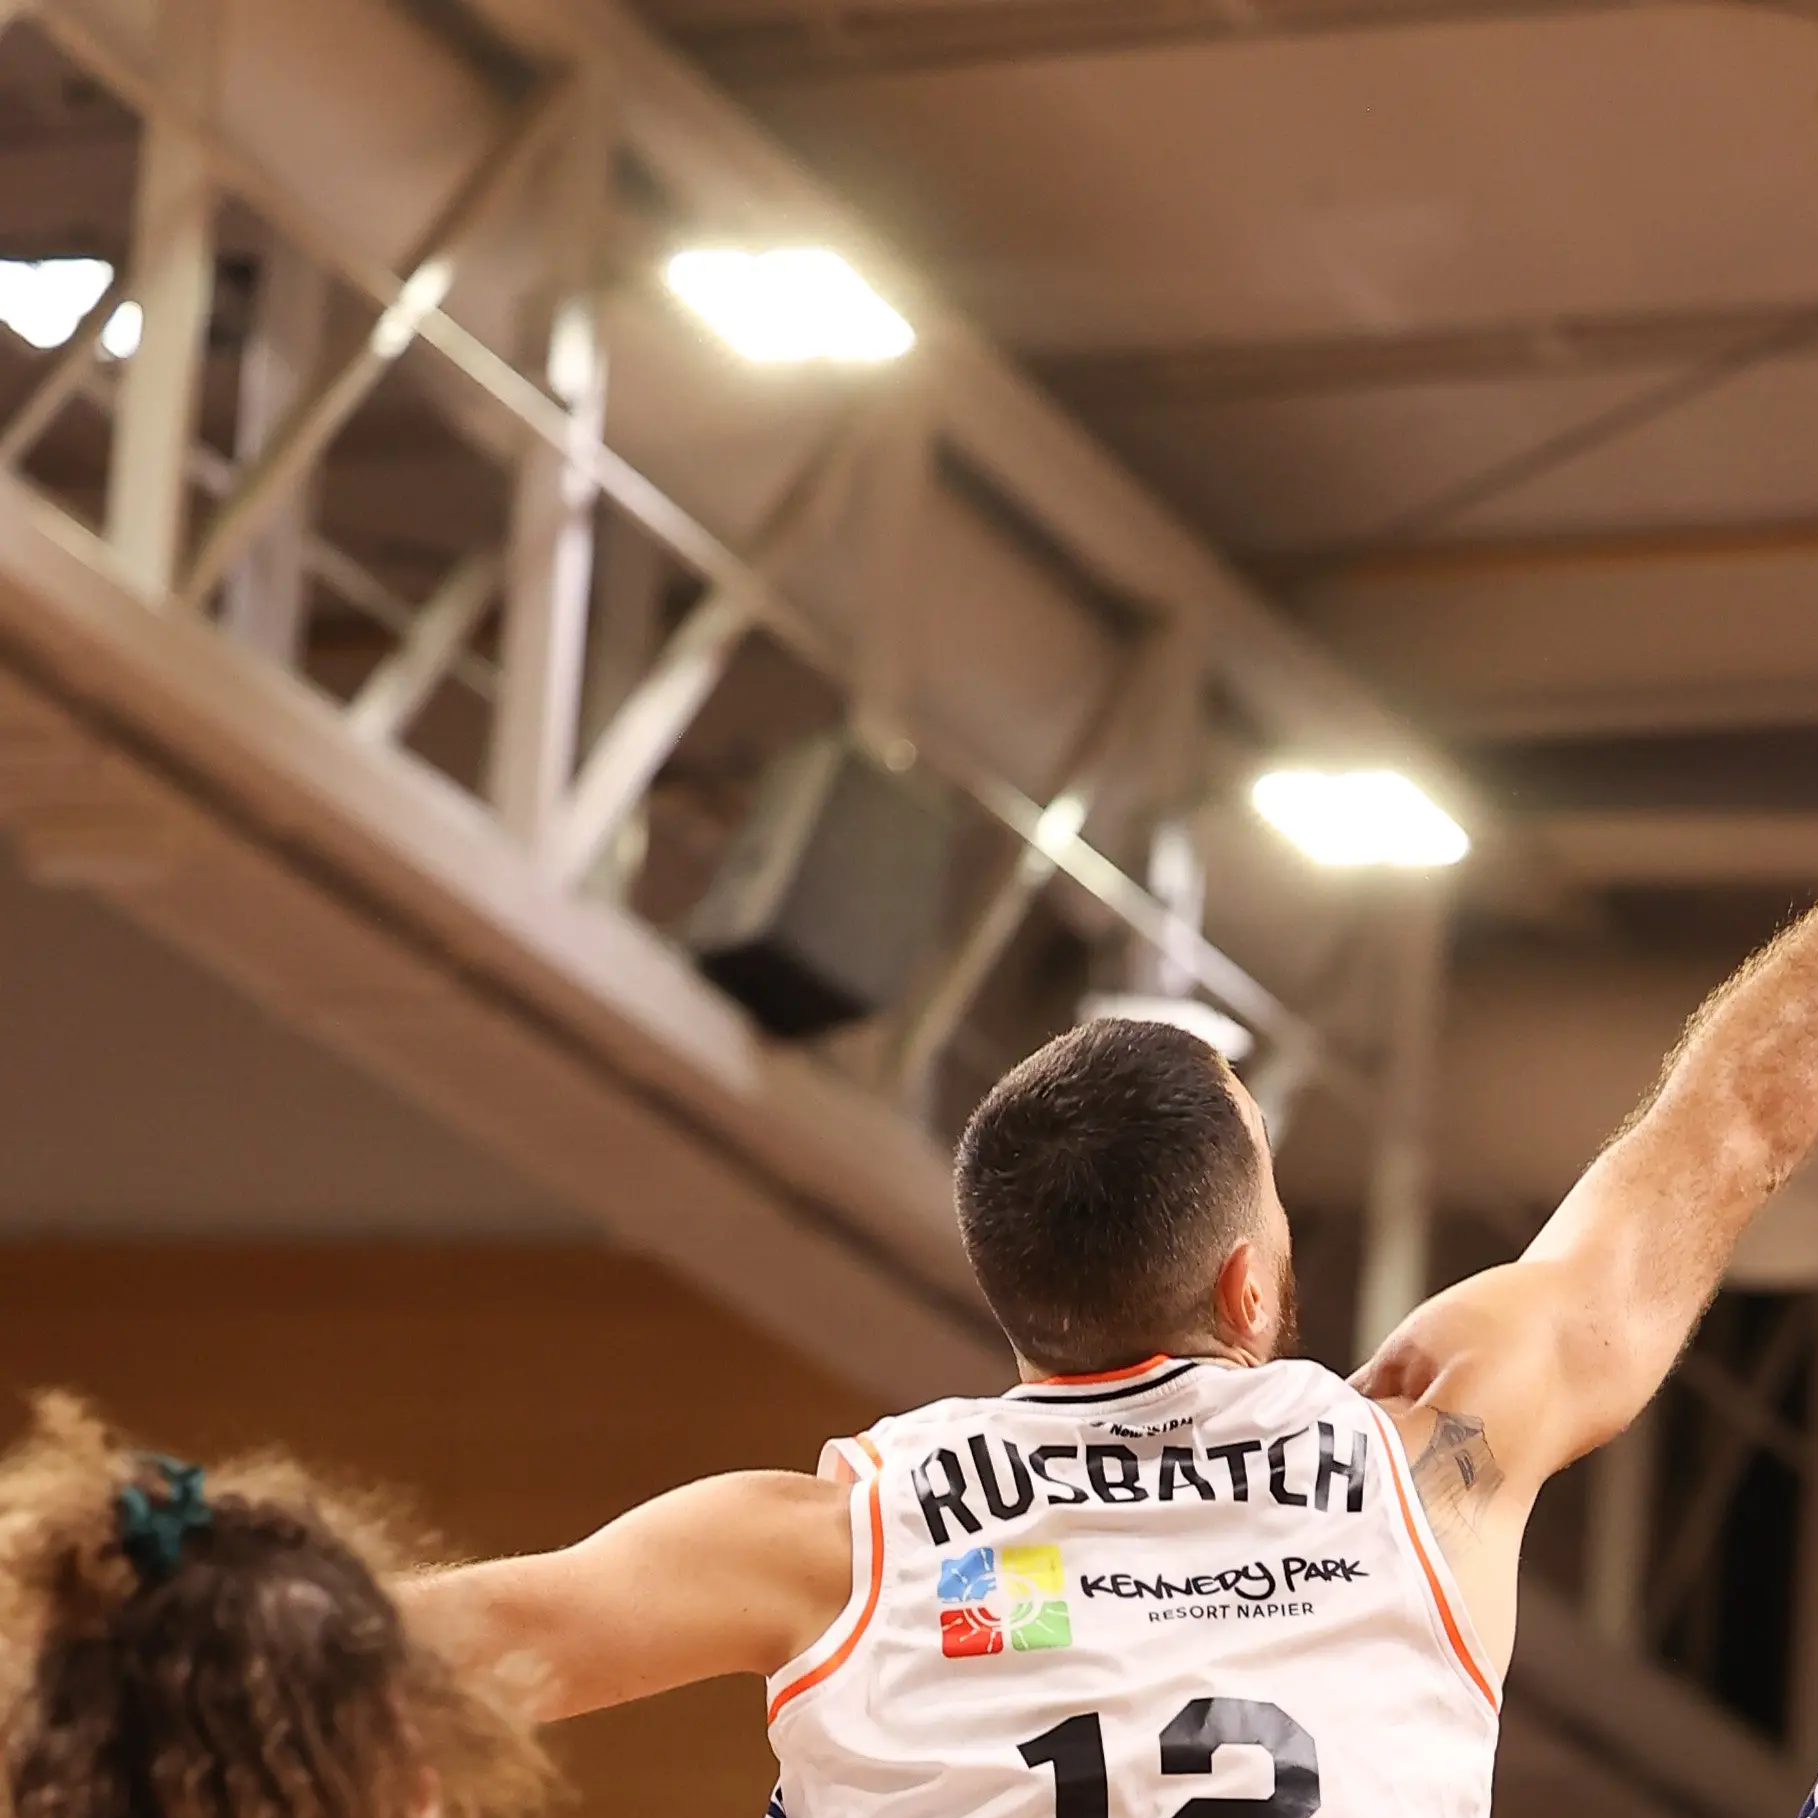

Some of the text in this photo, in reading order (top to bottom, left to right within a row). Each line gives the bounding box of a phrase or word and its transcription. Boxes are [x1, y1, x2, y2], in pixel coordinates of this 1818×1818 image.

[910, 1420, 1368, 1546] RUSBATCH
[1081, 1556, 1369, 1601] KENNEDY PARK
[1149, 1601, 1314, 1623] RESORT NAPIER
